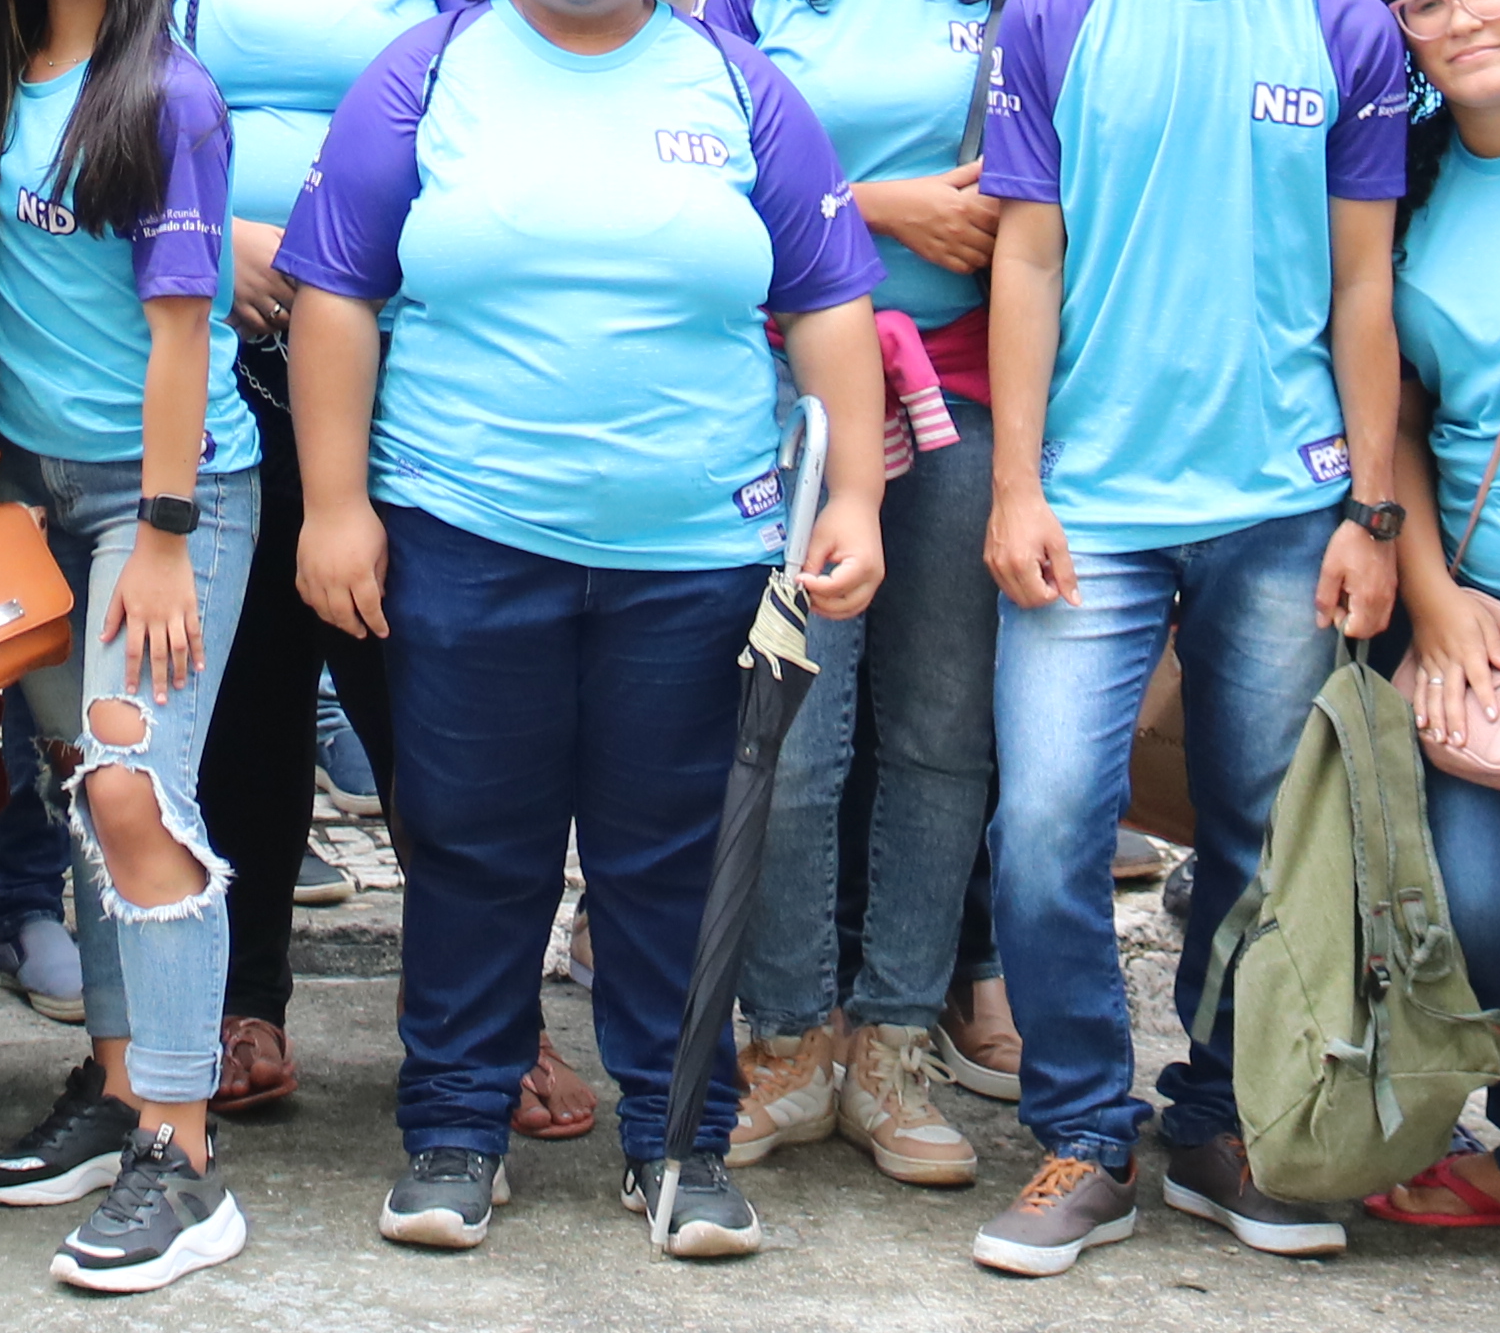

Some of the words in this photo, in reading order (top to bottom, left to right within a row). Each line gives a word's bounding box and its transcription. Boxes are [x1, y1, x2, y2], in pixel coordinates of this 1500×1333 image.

[1252, 81, 1326, 127] NiD
[655, 130, 730, 168] NiD
[17, 186, 78, 235] NiD
